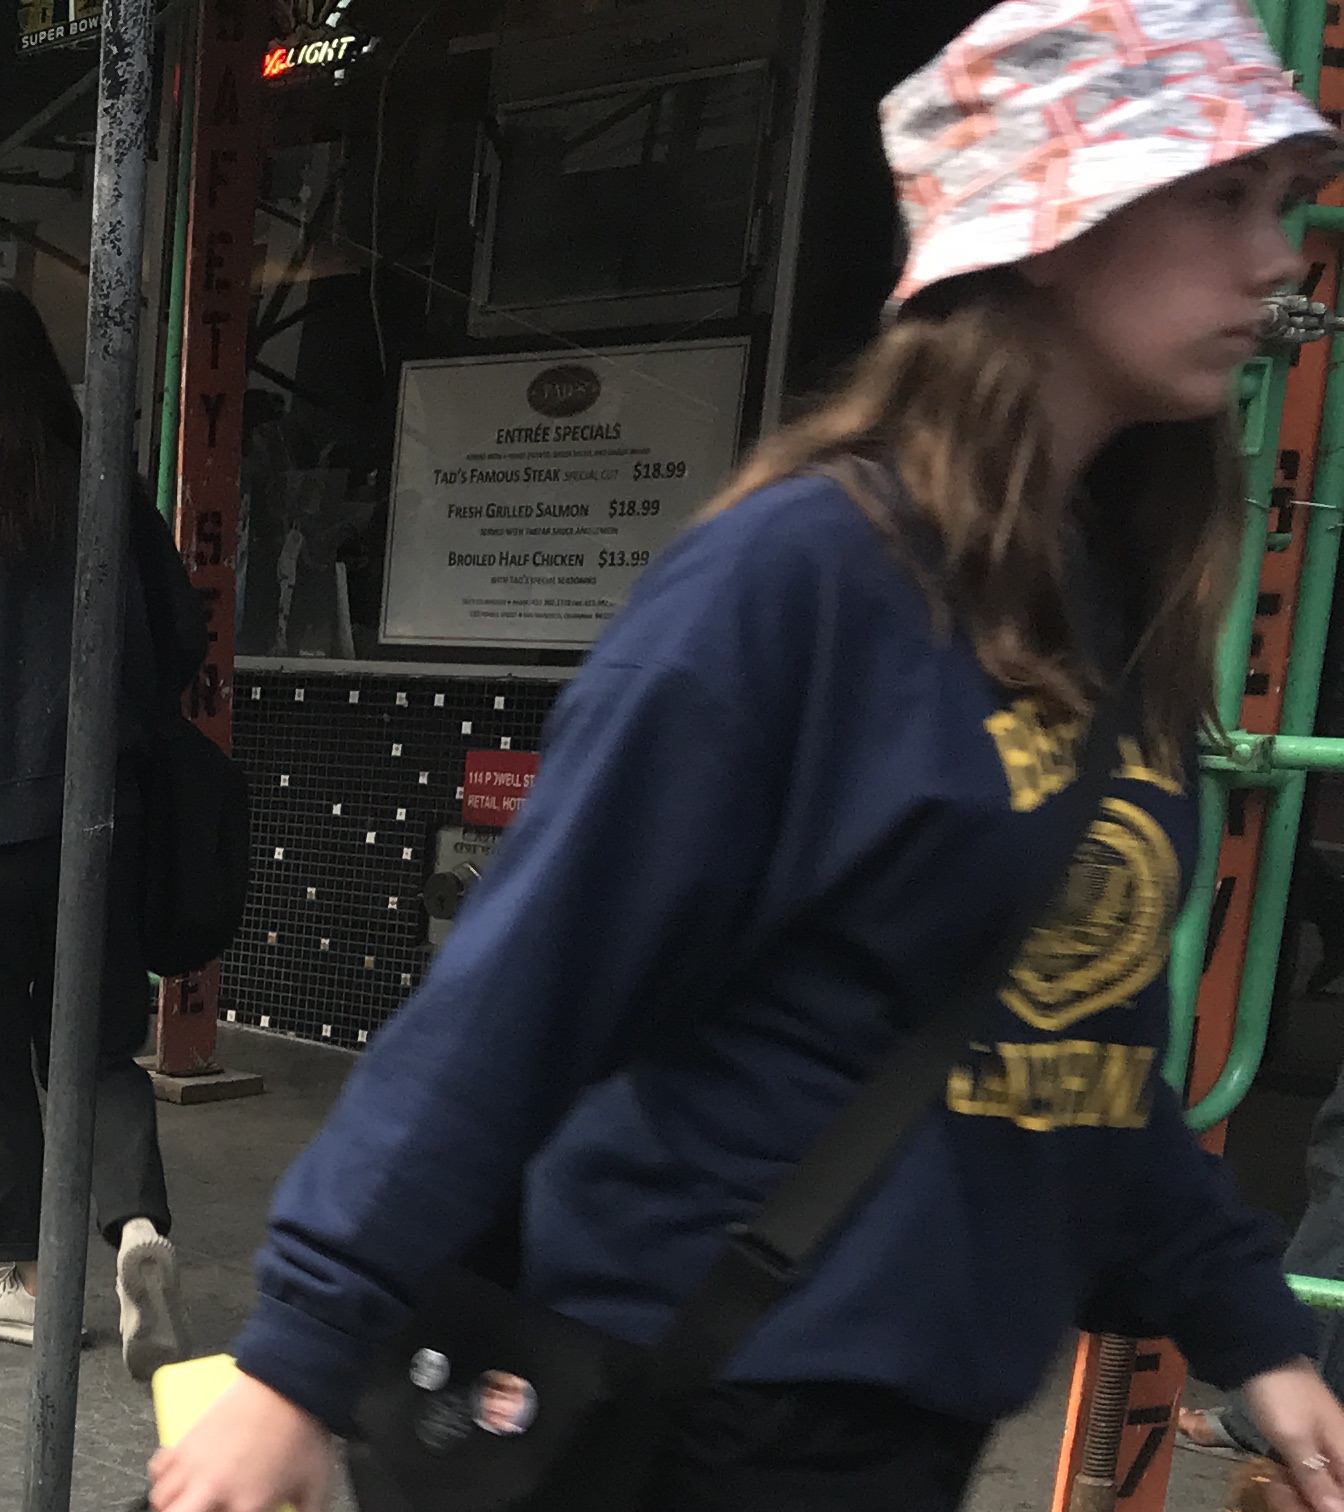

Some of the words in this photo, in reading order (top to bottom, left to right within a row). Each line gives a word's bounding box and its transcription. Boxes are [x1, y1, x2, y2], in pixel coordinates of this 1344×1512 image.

[21, 25, 65, 49] SUPER
[69, 15, 100, 35] BOW
[286, 35, 356, 68] LIGHT
[496, 423, 551, 445] ENTRÉE
[552, 422, 622, 442] SPECIALS
[470, 467, 520, 484] FAMOUS
[522, 467, 561, 483] STEAK
[633, 461, 687, 481] $18.99
[447, 503, 483, 518] FRESH
[485, 502, 534, 518] GRILLED
[535, 502, 590, 518] SALMON
[609, 499, 660, 518] $18.99
[448, 551, 496, 567] BROILED
[498, 551, 530, 567] HALF
[532, 551, 585, 567] CHICKEN
[598, 549, 650, 568] $13.99
[468, 771, 483, 784] 114
